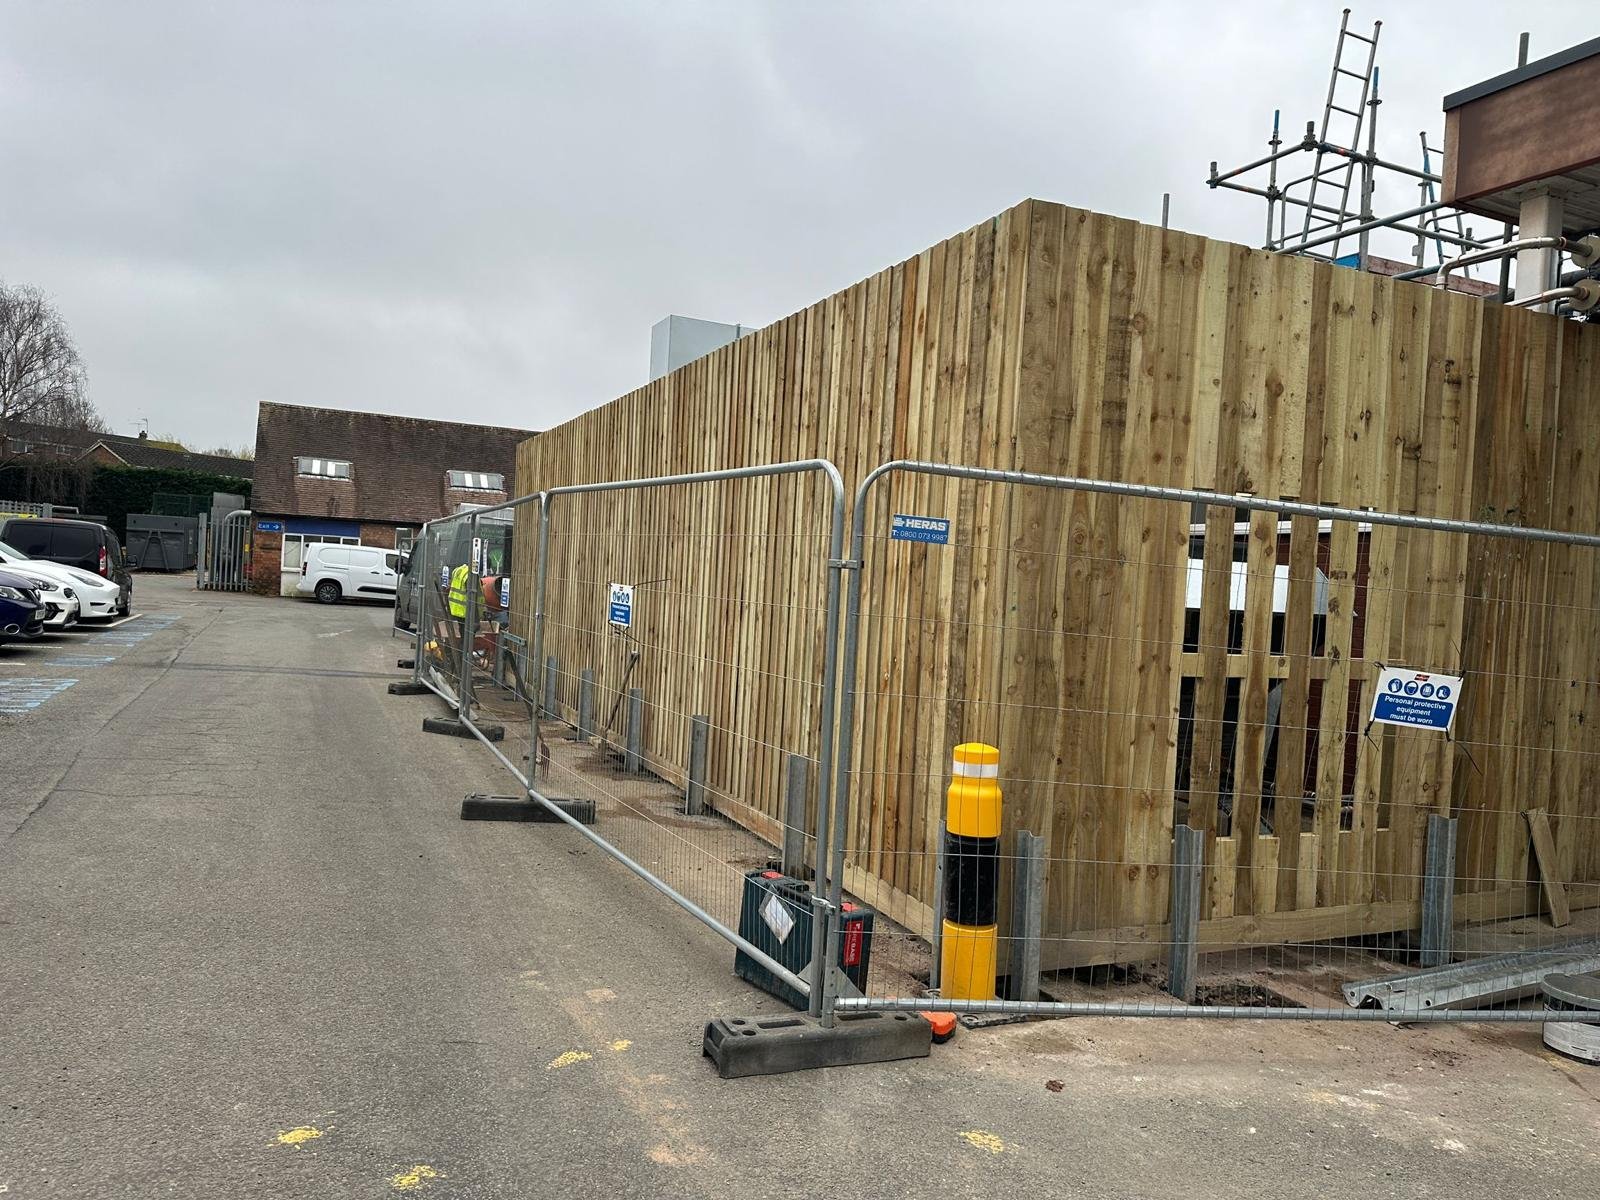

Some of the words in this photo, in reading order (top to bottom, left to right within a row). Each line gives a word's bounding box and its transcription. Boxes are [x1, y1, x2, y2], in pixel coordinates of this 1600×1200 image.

[905, 518, 946, 531] HERAS
[900, 530, 917, 538] 0800
[918, 532, 931, 540] 073
[1384, 695, 1413, 706] Personal
[1413, 700, 1447, 710] protective
[1396, 706, 1431, 716] equipment
[1389, 713, 1406, 721] must
